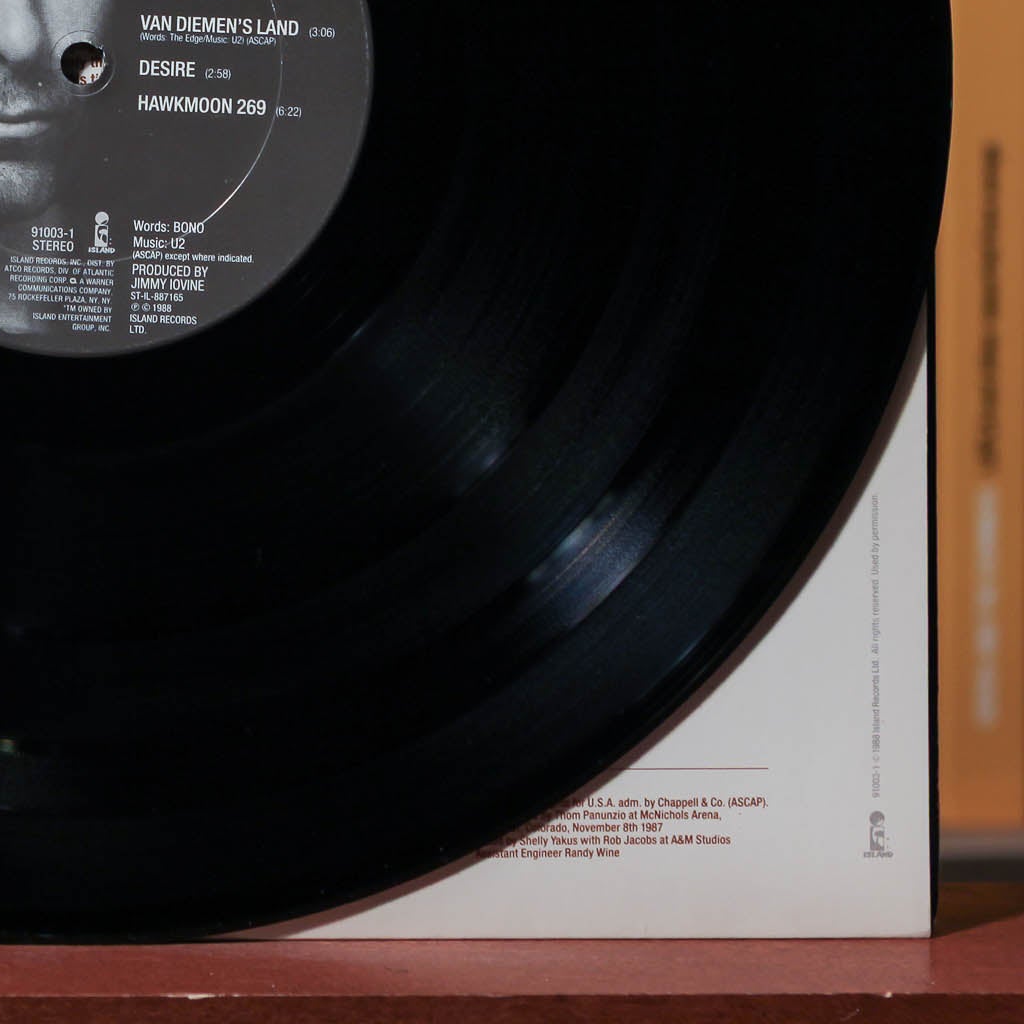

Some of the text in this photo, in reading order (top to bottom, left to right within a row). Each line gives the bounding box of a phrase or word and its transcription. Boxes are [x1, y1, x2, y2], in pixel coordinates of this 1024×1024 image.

[141, 15, 335, 39] VAN DIEMEN'S LAND (3:06)
[170, 33, 183, 42] The
[232, 36, 244, 44] U2)
[247, 37, 276, 45] (ASCAP)
[140, 60, 231, 80] DESIRE (2:58)
[138, 95, 301, 118] HAWKMOON 269 (6:22)
[32, 227, 74, 238] 91003-1
[134, 220, 204, 233] Words: BONO
[33, 240, 74, 252] STEREO
[133, 236, 185, 249] Music: U2
[132, 251, 254, 263] (ASCAP) except where indicated.
[132, 264, 208, 277] PRODUCED BY
[10, 274, 47, 283] RECORDING
[86, 278, 114, 286] WARNER
[131, 277, 205, 291] JIMMY IOVINE
[18, 284, 77, 294] COMMUNICATIONS
[131, 292, 183, 302] ST-IL-887165
[153, 304, 172, 313] 1988
[33, 312, 112, 323] ISLAND ENTERTAINMENT
[130, 314, 197, 325] ISLAND RECORDS
[588, 797, 768, 809] U.S.A. adm. by Chappell & Co. (ASCAP).
[583, 810, 722, 820] Panunzio at McNichols Arena,
[572, 823, 663, 832] November 8th 1987
[520, 834, 731, 847] Shelly Yakus with Rob Jacobs at A&M Studios
[521, 848, 620, 860] Engineer Randy Wine
